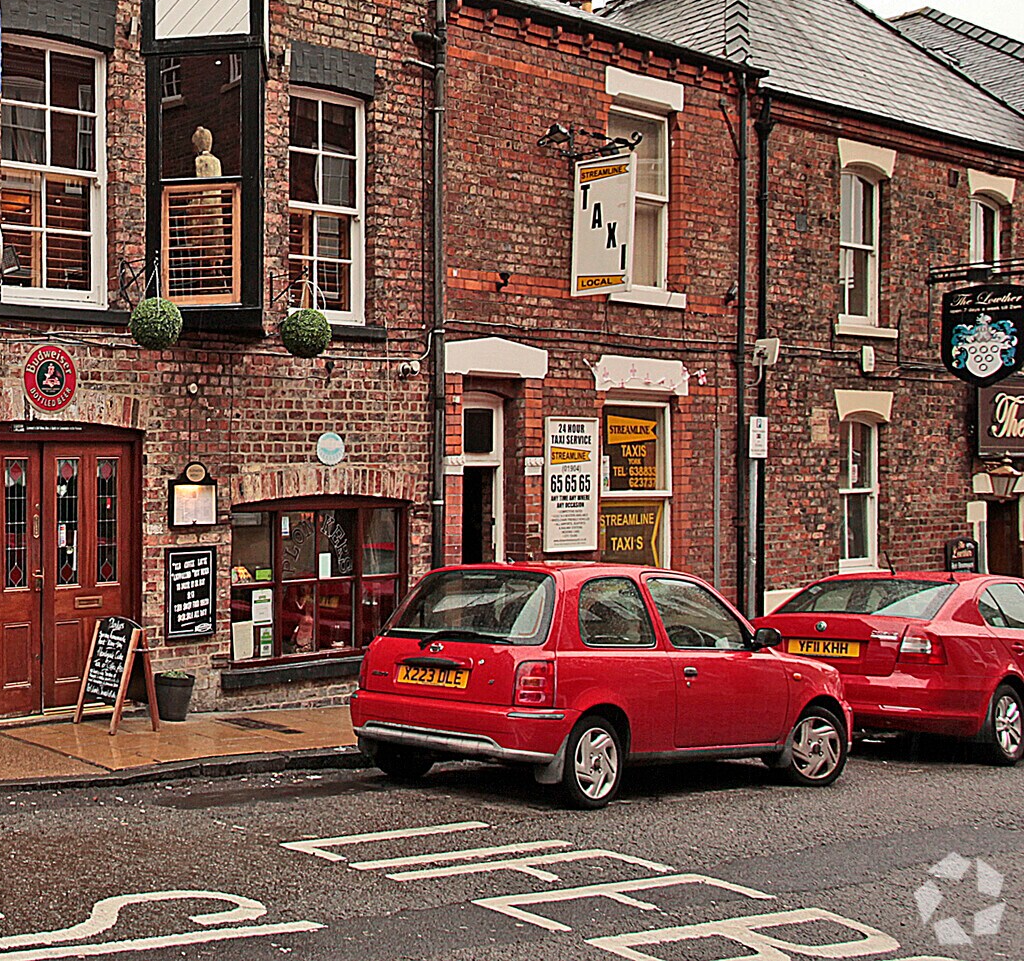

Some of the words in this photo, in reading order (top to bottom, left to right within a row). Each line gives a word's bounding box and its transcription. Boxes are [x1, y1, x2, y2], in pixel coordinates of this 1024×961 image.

[581, 167, 622, 179] STREAMLINE
[581, 184, 626, 270] TAXI
[581, 278, 612, 287] LOCAL
[950, 294, 972, 306] The
[976, 291, 1023, 305] Lowther
[26, 350, 72, 374] Budweiser
[30, 387, 56, 407] BOTTLED
[58, 387, 71, 405] BEER
[992, 392, 1024, 438] The
[558, 424, 566, 433] 24
[568, 424, 585, 433] HOUR
[609, 425, 650, 434] STREAMLINE
[551, 435, 565, 444] TAXI
[566, 435, 591, 445] SERVICE
[552, 451, 586, 460] STREAMLINE
[621, 445, 647, 457] TAXIS
[562, 465, 581, 473] (01904)
[629, 466, 656, 476] 638833
[551, 475, 562, 493] 65
[565, 475, 576, 493] 65
[579, 475, 590, 493] 65
[629, 478, 656, 488] 623737
[600, 513, 654, 526] STREAMLINE
[798, 641, 819, 652] YF11
[823, 642, 849, 654] KHH
[403, 666, 435, 682] X223
[438, 668, 463, 685] DLE
